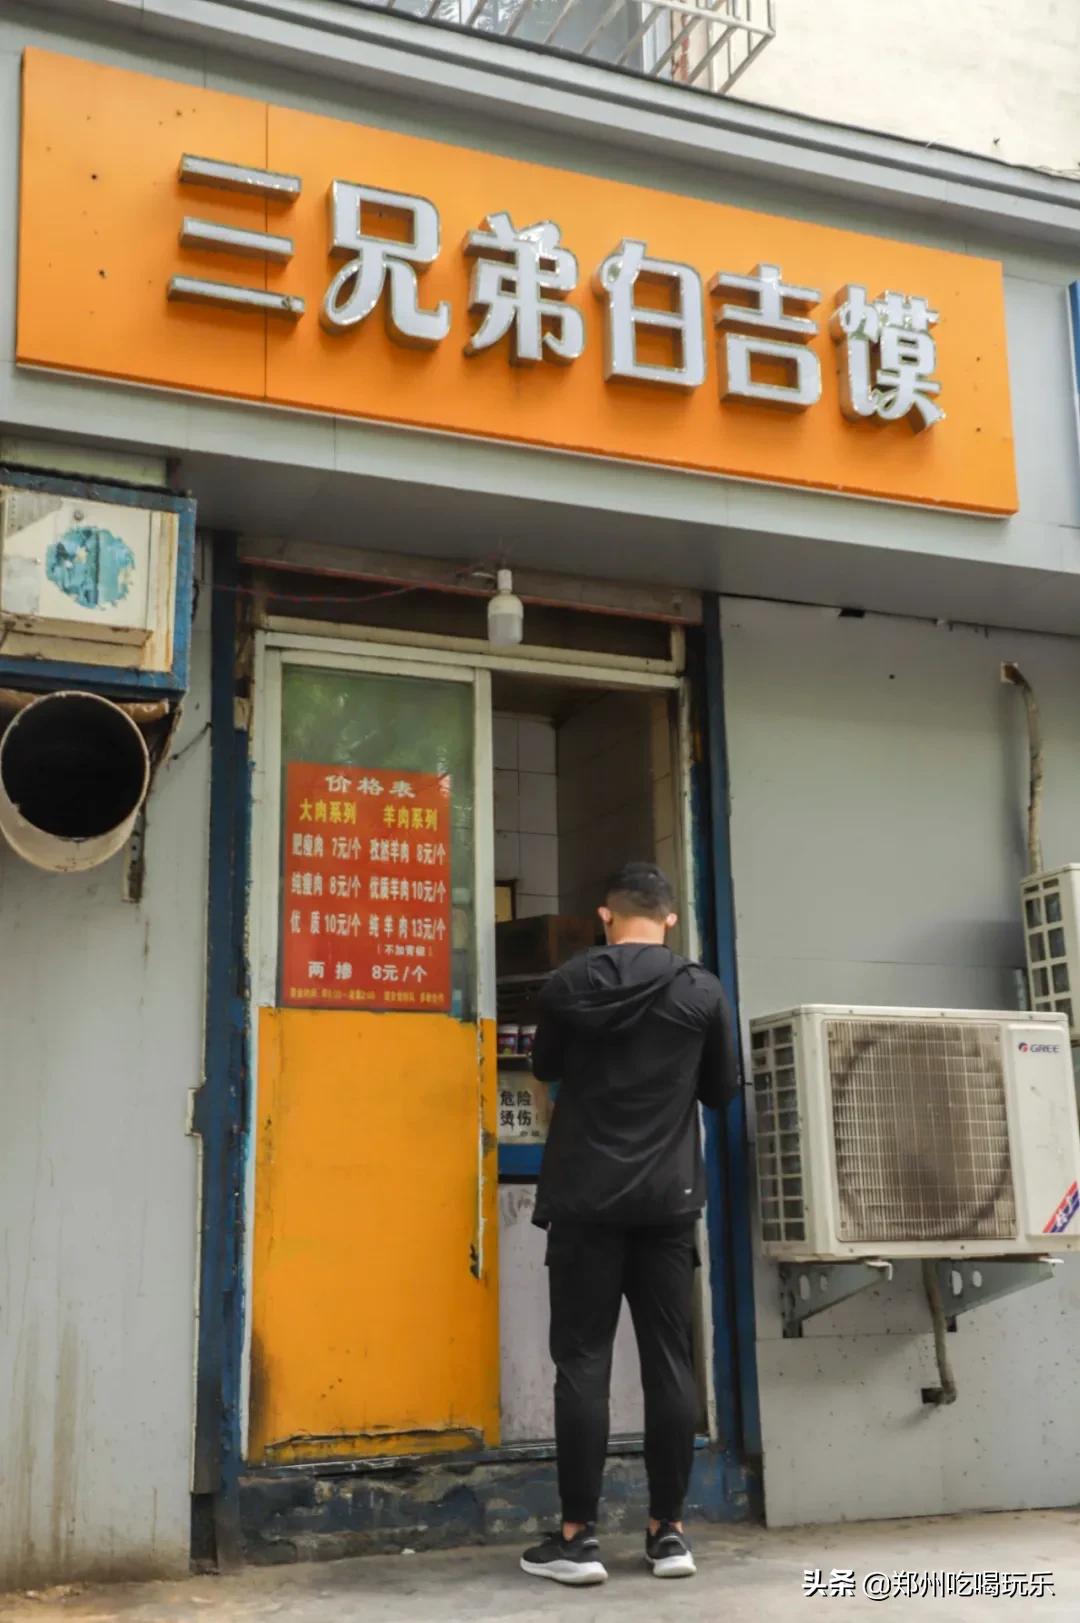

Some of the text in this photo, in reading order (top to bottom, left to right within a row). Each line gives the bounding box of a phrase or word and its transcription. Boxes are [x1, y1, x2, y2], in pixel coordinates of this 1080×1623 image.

[167, 152, 946, 432] 三兄弟白吉馍
[324, 775, 416, 798] 价格表
[299, 798, 357, 825] 大肉系列
[383, 805, 439, 832] 羊肉系列
[292, 832, 361, 860] 肥瘦肉 7元/个
[369, 838, 446, 866] 孜然羊肉 8元/个
[291, 871, 361, 899] 纯瘦肉 8元/个
[369, 876, 446, 904] 优质羊肉 10元/个
[324, 912, 361, 938] 10元/个
[368, 913, 446, 941] 纯羊肉 13元/个
[371, 964, 428, 983] 8元/个
[1030, 1044, 1060, 1053] GREE
[500, 1090, 532, 1107] 危险
[500, 1110, 532, 1128] 烫伤
